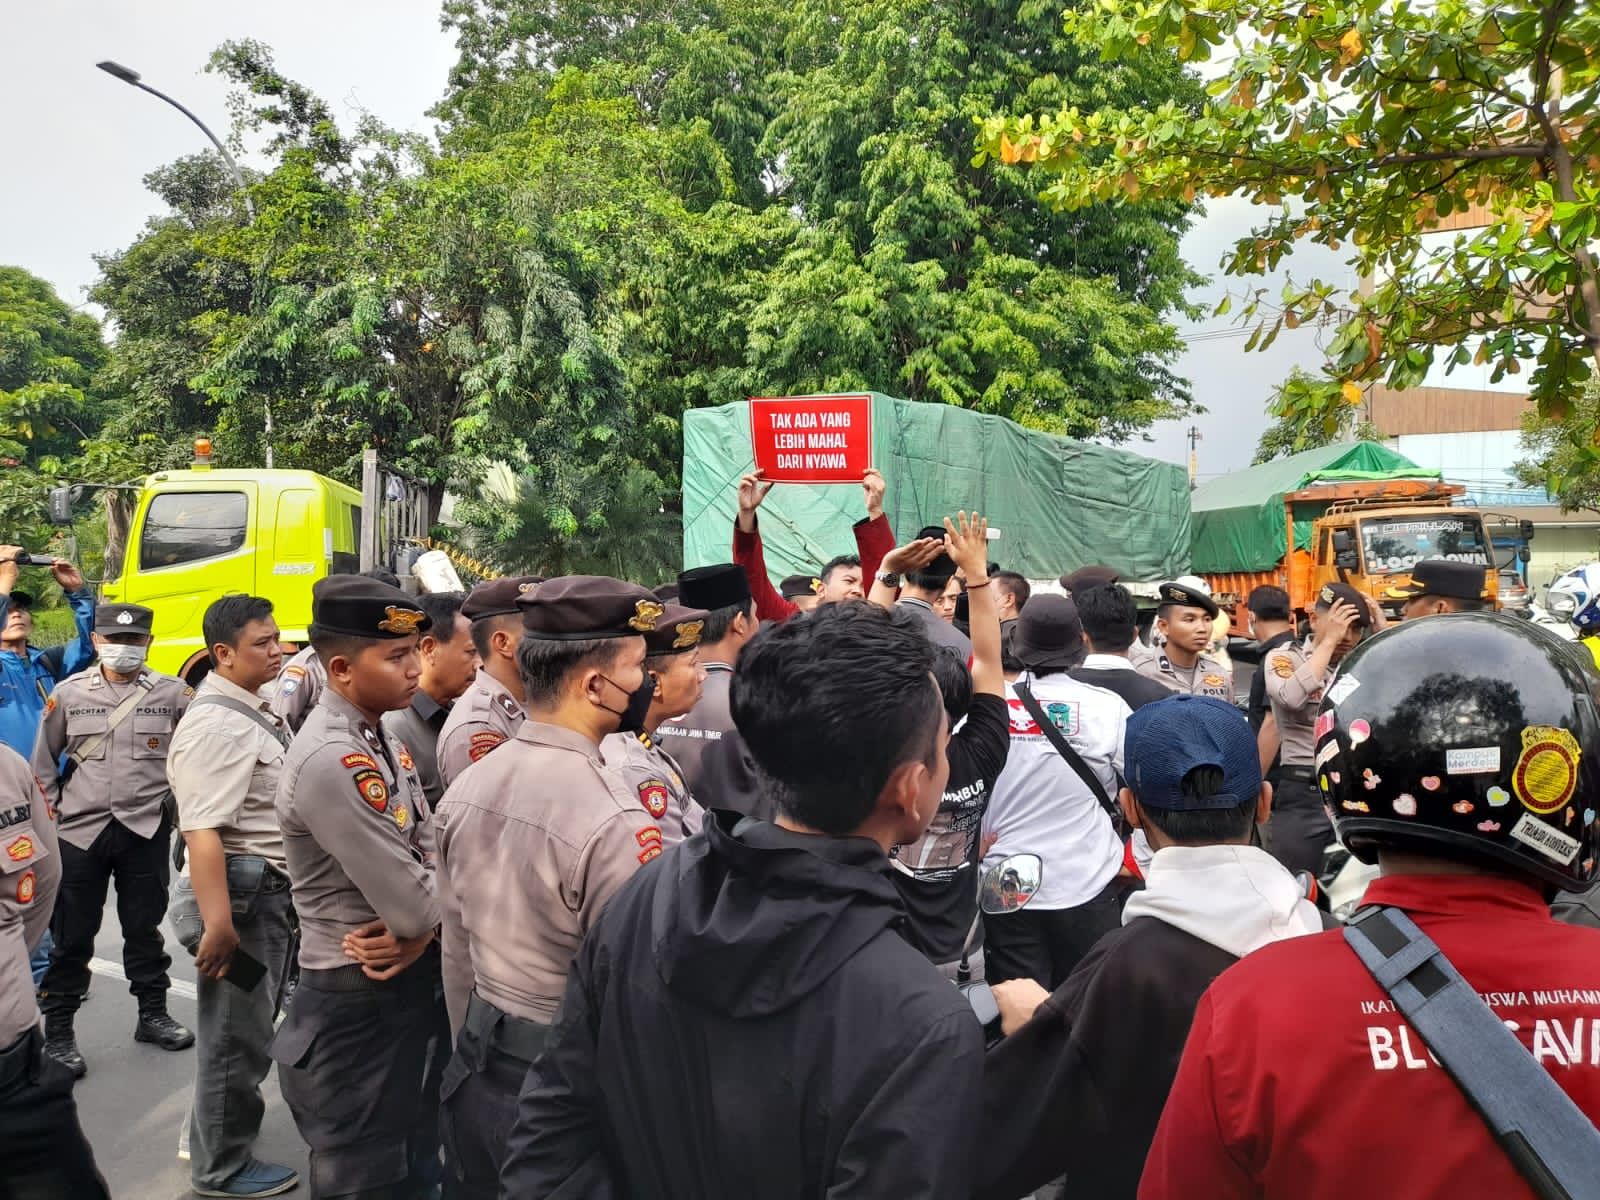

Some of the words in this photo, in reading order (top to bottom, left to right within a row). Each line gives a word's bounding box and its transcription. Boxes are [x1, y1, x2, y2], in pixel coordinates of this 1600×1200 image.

[769, 413, 792, 429] TAK
[794, 412, 818, 428] ADA
[820, 412, 851, 428] YANG
[774, 433, 805, 449] LEBIH
[807, 433, 848, 448] MAHAL
[777, 454, 803, 469] DARI
[805, 453, 847, 469] NYAWA
[688, 728, 703, 739] JAWA
[1478, 991, 1530, 1007] ISWA
[1533, 989, 1600, 1006] MUHAM
[1367, 1024, 1443, 1071] BL
[1503, 1017, 1600, 1066] AV
